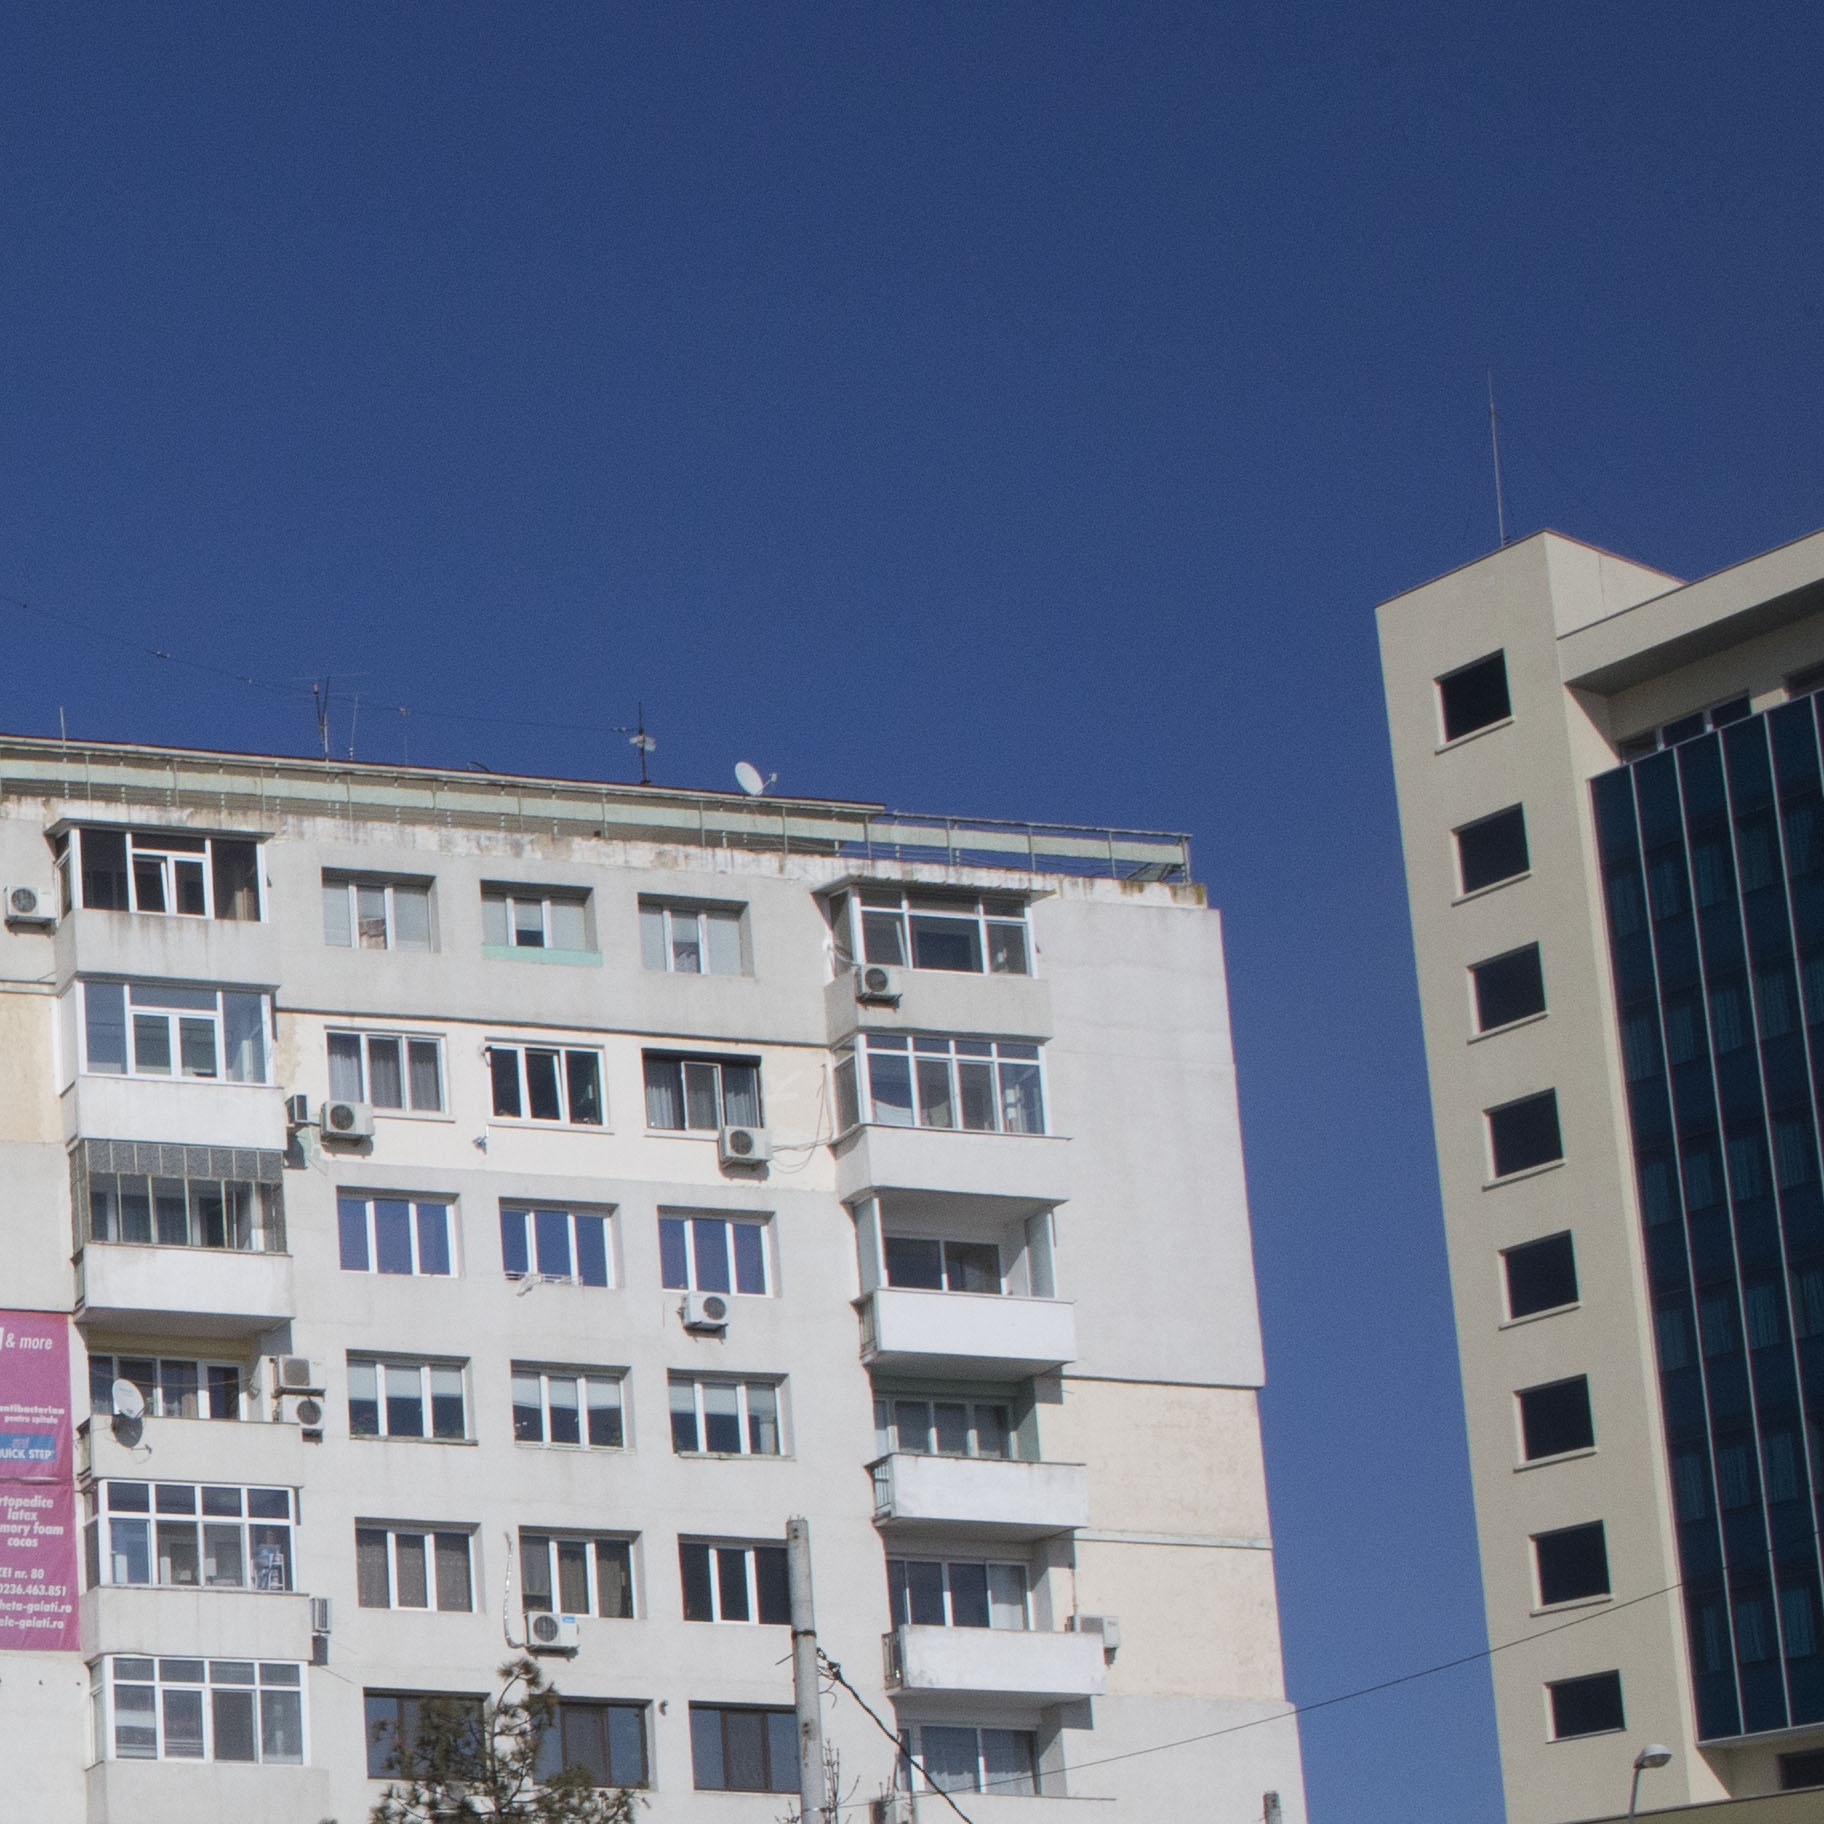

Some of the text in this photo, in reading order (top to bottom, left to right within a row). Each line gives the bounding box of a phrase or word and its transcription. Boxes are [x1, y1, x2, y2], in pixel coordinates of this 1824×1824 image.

[6, 1333, 16, 1348] &
[19, 1336, 53, 1350] more
[28, 1449, 52, 1460] STEP
[7, 1508, 38, 1521] latex
[33, 1522, 64, 1535] foam
[7, 1537, 39, 1547] cocos
[14, 1570, 28, 1579] nr.
